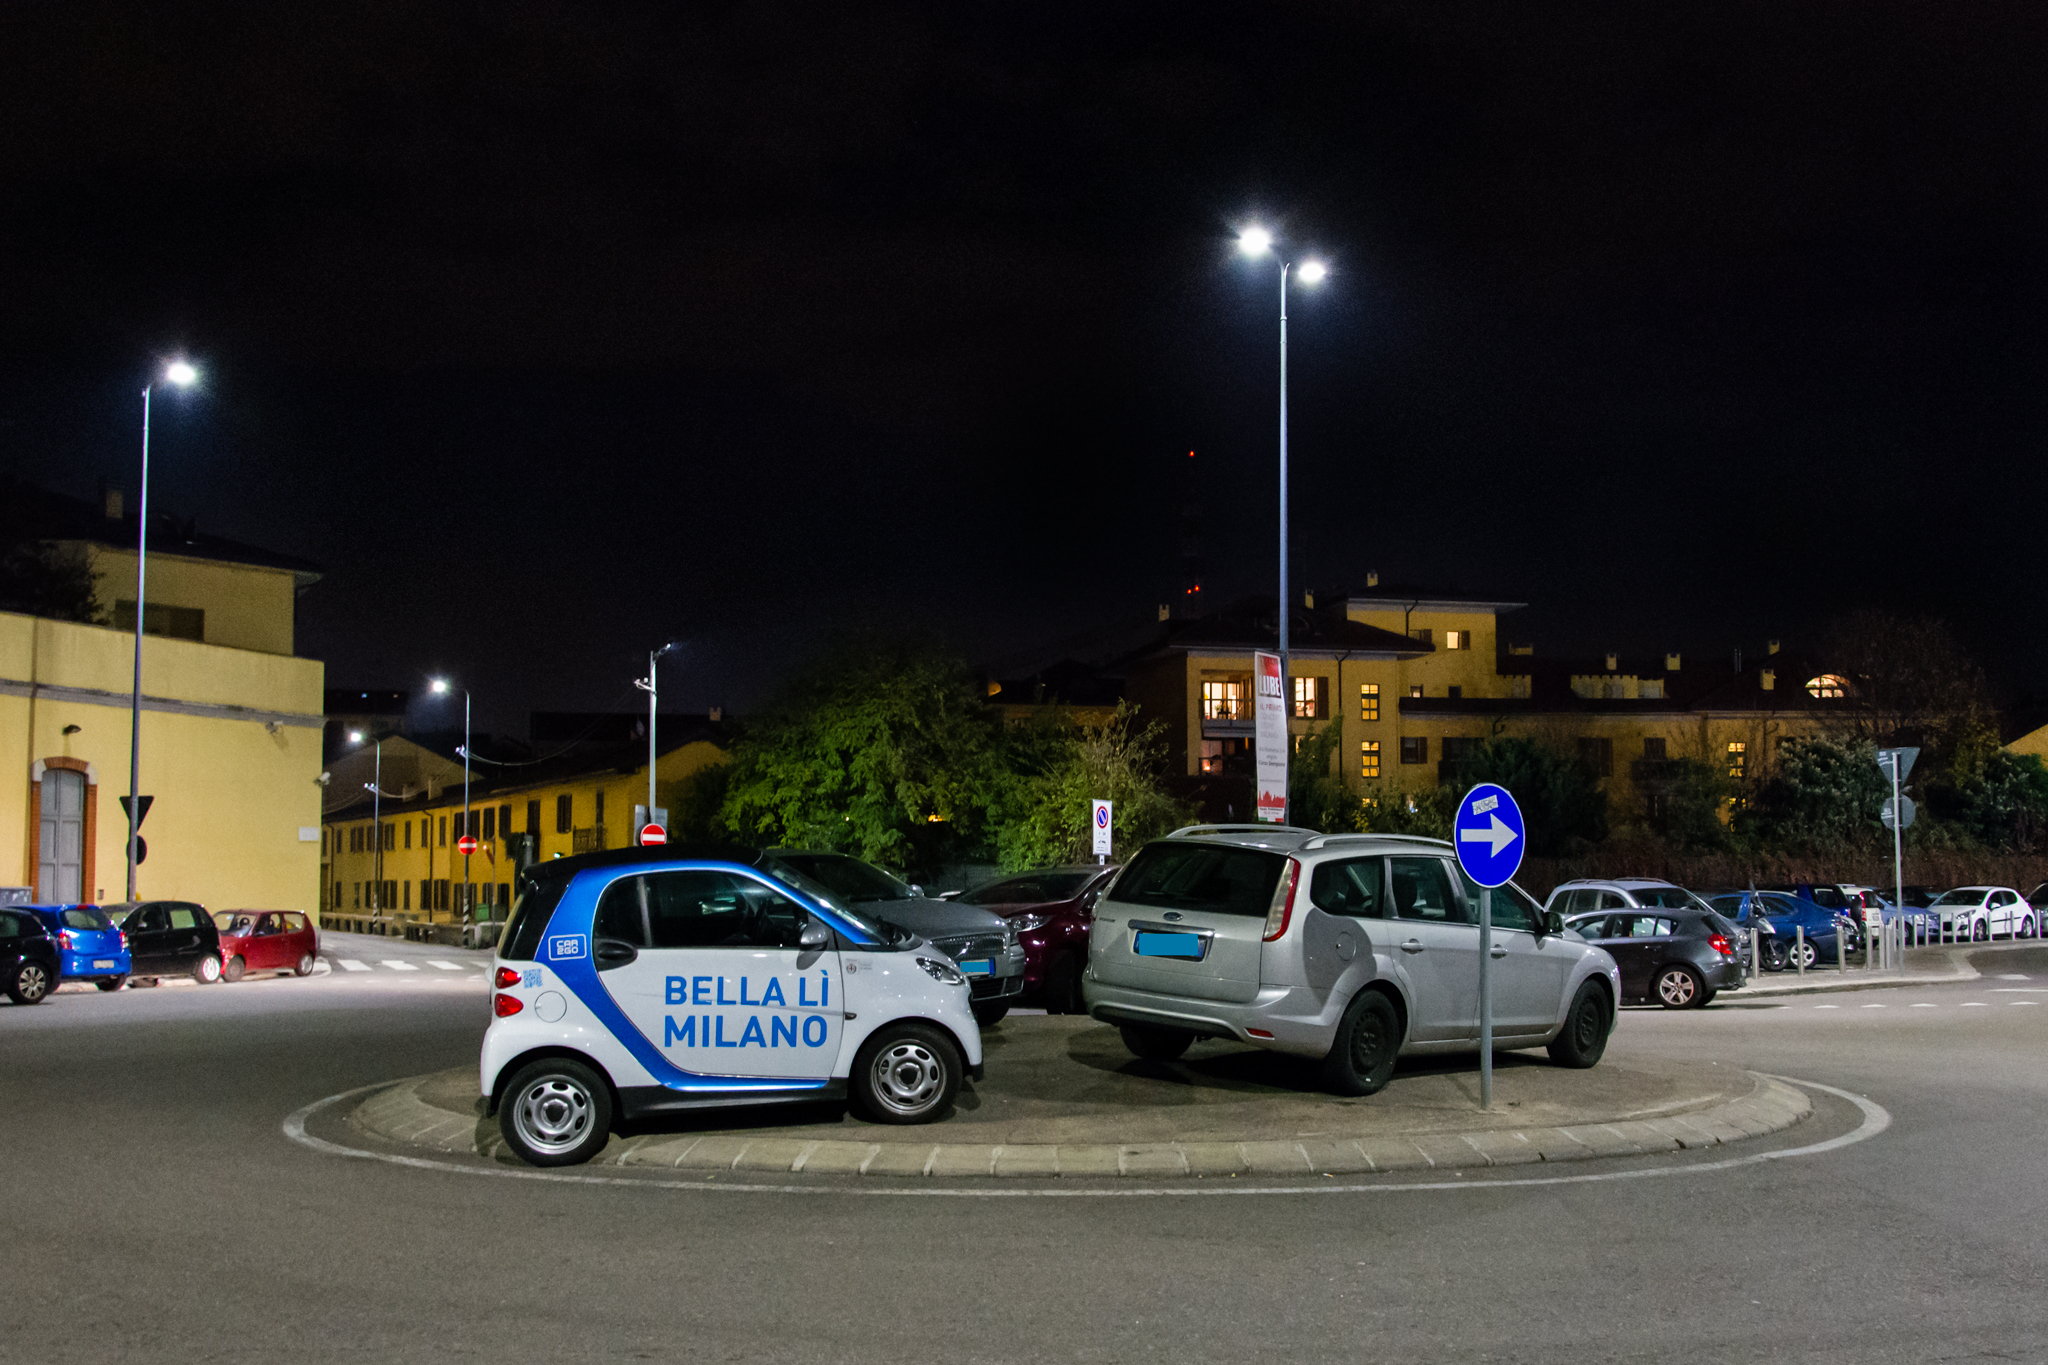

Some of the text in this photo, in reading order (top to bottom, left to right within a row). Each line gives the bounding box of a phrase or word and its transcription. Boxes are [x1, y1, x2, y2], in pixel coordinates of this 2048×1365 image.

[1259, 675, 1281, 696] LUBE
[556, 939, 578, 948] CAR
[557, 946, 579, 955] 2GO
[665, 969, 829, 1006] BELLA LÌ
[664, 1014, 828, 1048] MILANO
